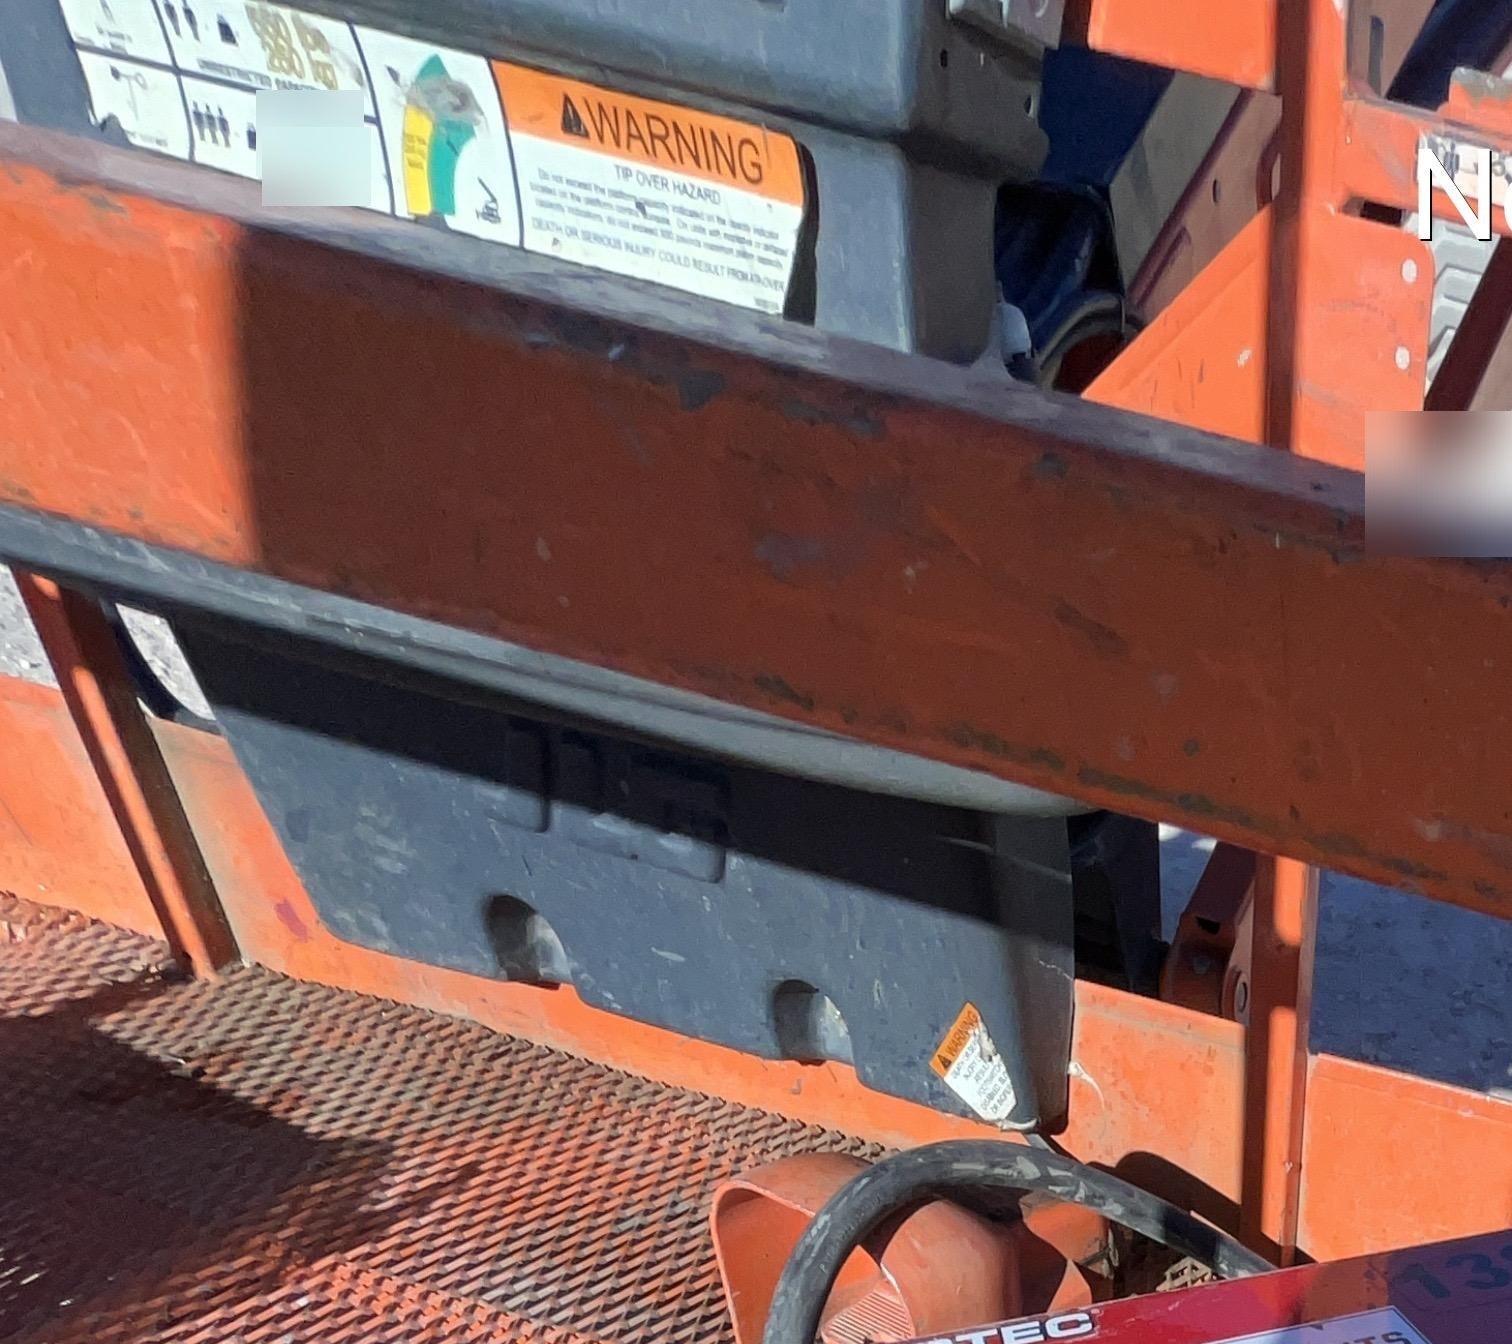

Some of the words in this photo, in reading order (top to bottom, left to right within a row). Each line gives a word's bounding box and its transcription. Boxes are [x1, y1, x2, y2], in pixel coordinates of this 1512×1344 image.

[584, 96, 763, 184] WARNING
[614, 165, 633, 180] TIP
[636, 172, 670, 192] OVER
[673, 179, 721, 204] HAZARD
